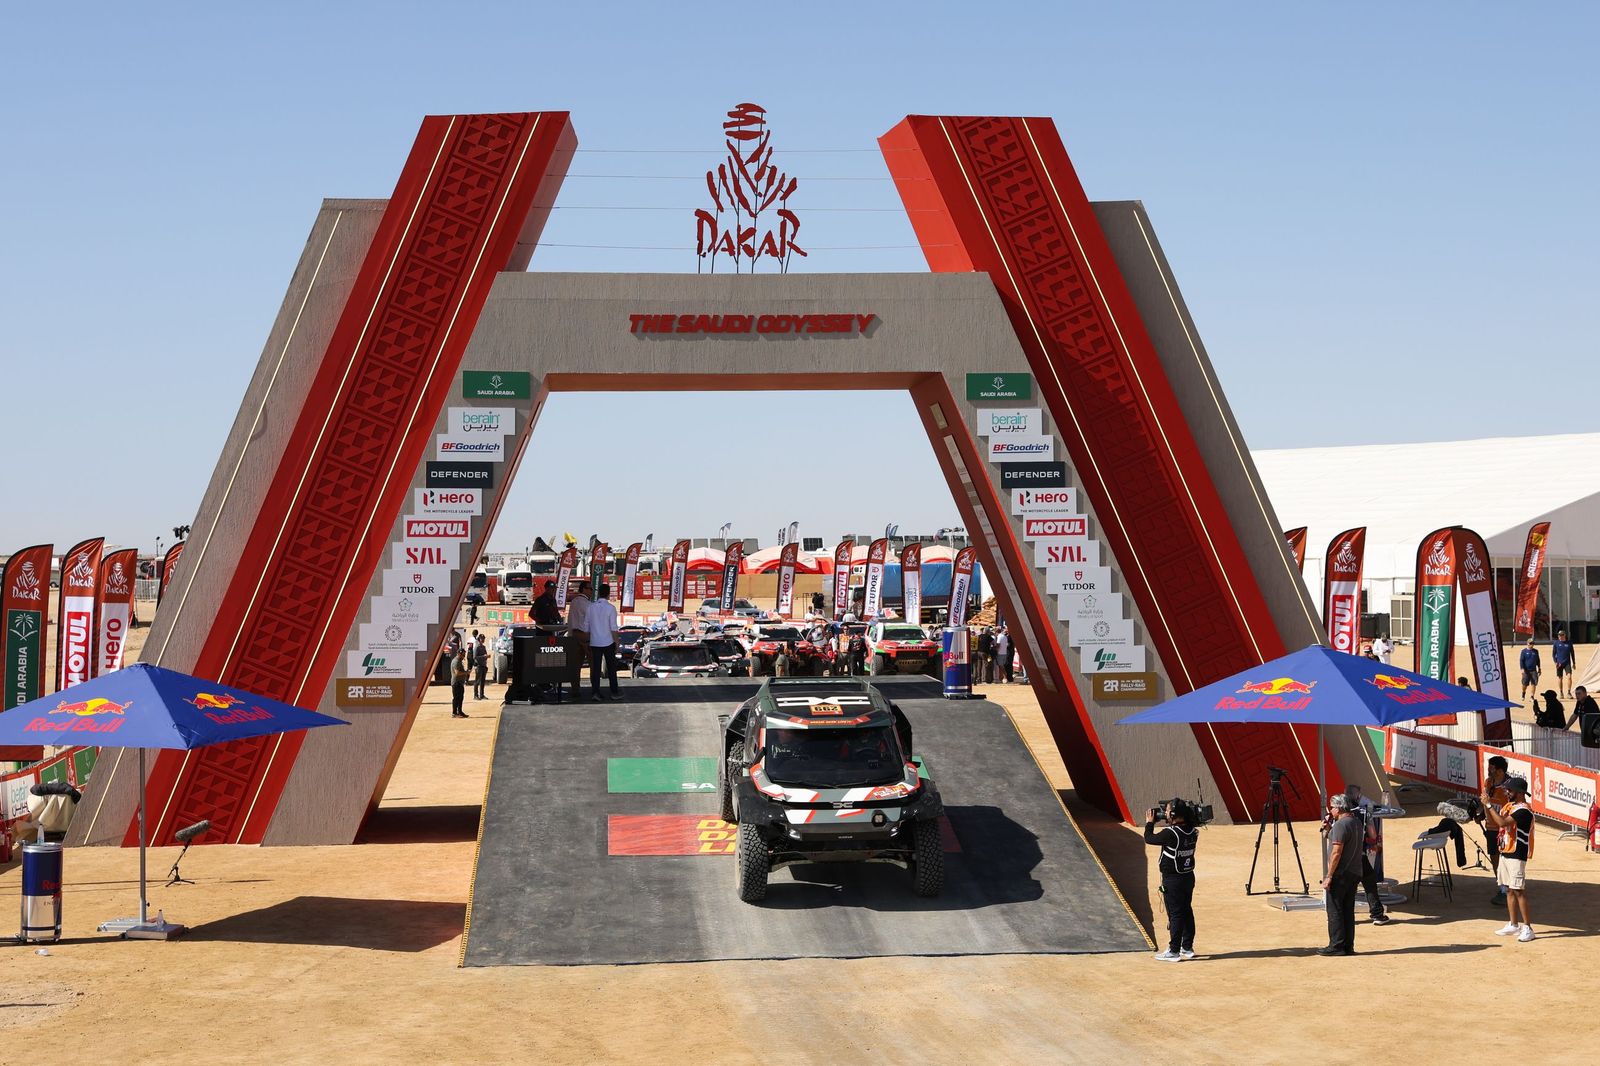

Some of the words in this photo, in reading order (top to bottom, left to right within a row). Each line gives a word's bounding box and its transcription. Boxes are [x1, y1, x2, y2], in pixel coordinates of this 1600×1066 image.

[695, 208, 807, 257] DAKAR
[629, 314, 673, 333] THE
[676, 314, 754, 333] SAUDI
[756, 314, 876, 333] ODYSSEY
[463, 411, 498, 424] berain
[992, 412, 1027, 425] berain
[441, 442, 500, 451] BFGoodrich
[993, 443, 1049, 452] BFGoodrich
[431, 471, 488, 479] DEFENDER
[1005, 471, 1060, 479] DEFENDER
[439, 493, 474, 504] Hero
[1035, 492, 1068, 503] Hero
[410, 522, 466, 535] MOTUL
[1029, 521, 1082, 534] MOTUL
[1334, 562, 1357, 573] DAKAR
[1424, 564, 1452, 576] DAKAR
[69, 576, 94, 587] DAKAR
[1465, 569, 1485, 583] DAKAR
[12, 586, 41, 600] DAKAR
[105, 583, 129, 594] DAKAR
[400, 586, 434, 594] TUDOR
[558, 575, 568, 598] TUDOR
[724, 566, 735, 608] DEFENDER
[869, 574, 878, 605] TUDOR
[1062, 583, 1096, 591] TUDOR
[1334, 598, 1350, 654] OTUL
[105, 618, 122, 669] Hero
[1430, 618, 1440, 658] ARABIA
[68, 616, 87, 688] MOTUL
[1476, 632, 1494, 684] berain
[17, 647, 28, 689] ARABIA
[1430, 661, 1439, 680] UDI
[1214, 696, 1262, 710] Red
[1260, 696, 1313, 710] Bull
[24, 717, 72, 733] Red
[70, 717, 126, 733] Bull
[1549, 780, 1591, 804] BFGoodrich
